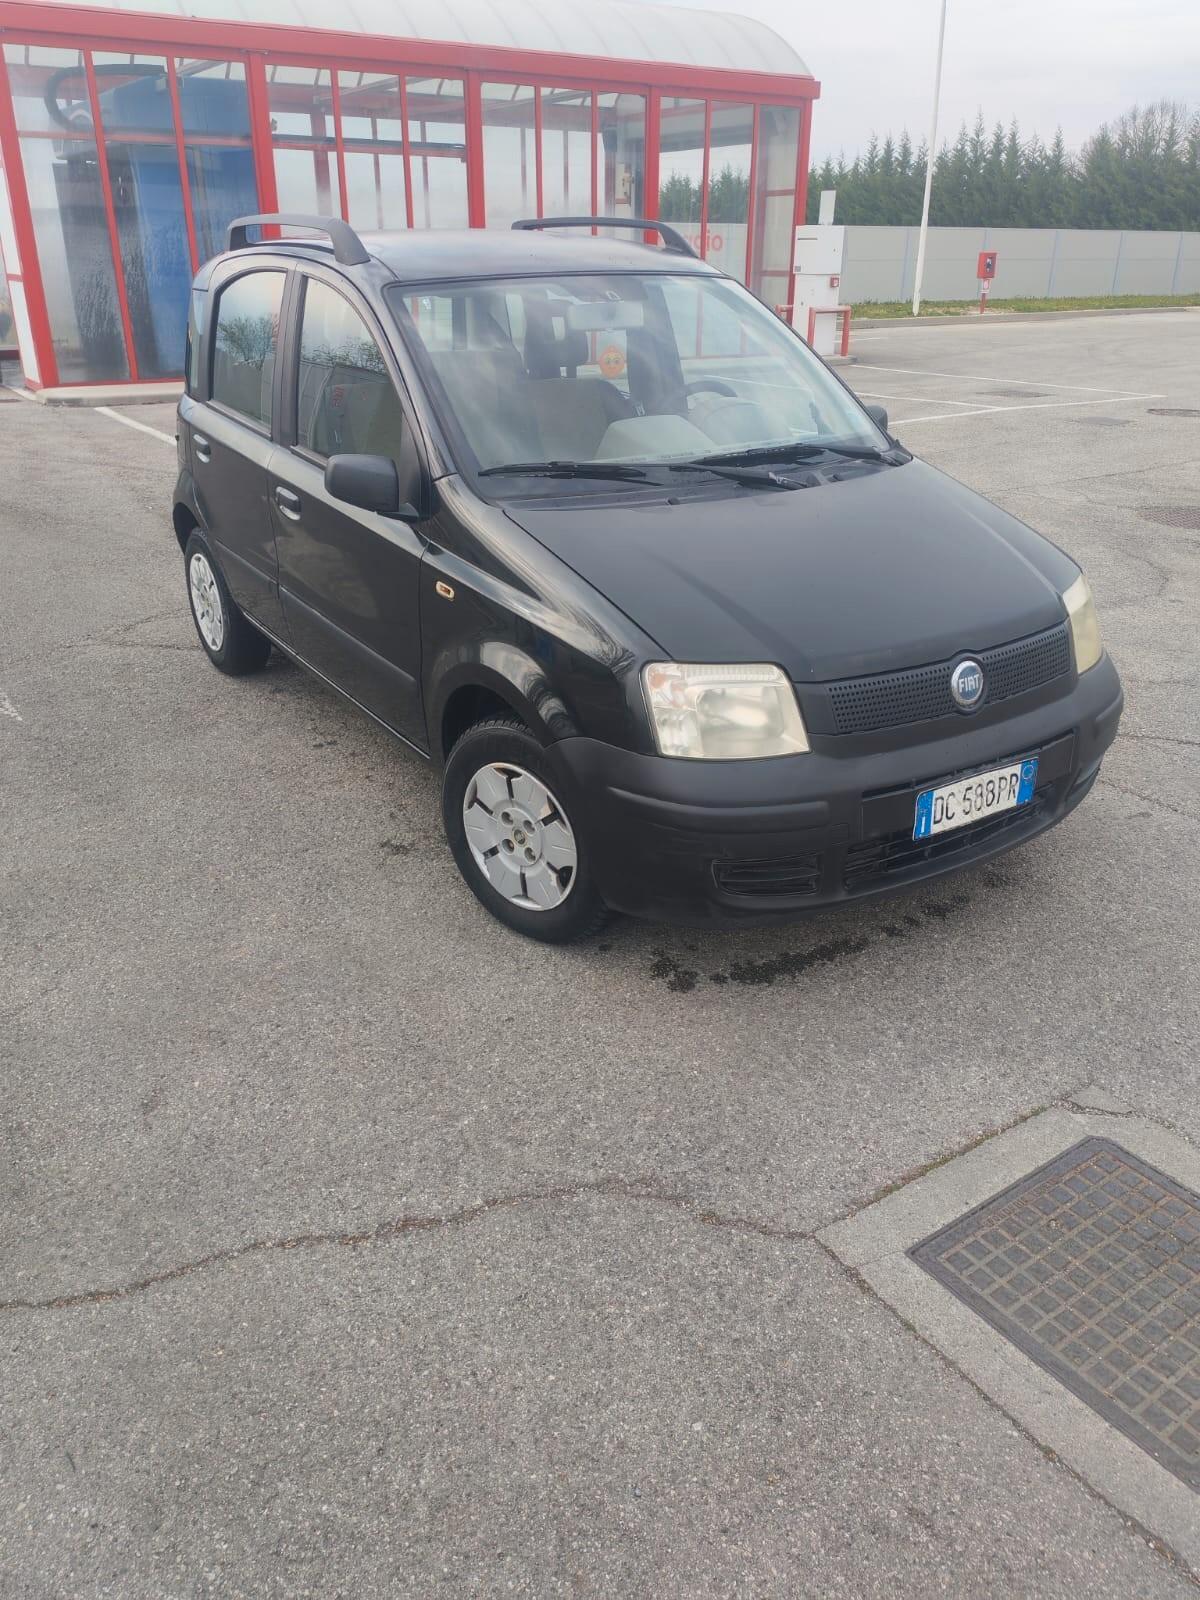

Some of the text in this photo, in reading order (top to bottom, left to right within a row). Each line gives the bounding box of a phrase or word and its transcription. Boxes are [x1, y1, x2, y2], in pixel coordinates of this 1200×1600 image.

[959, 674, 980, 693] FIAT
[933, 773, 1019, 825] DC 588PR
